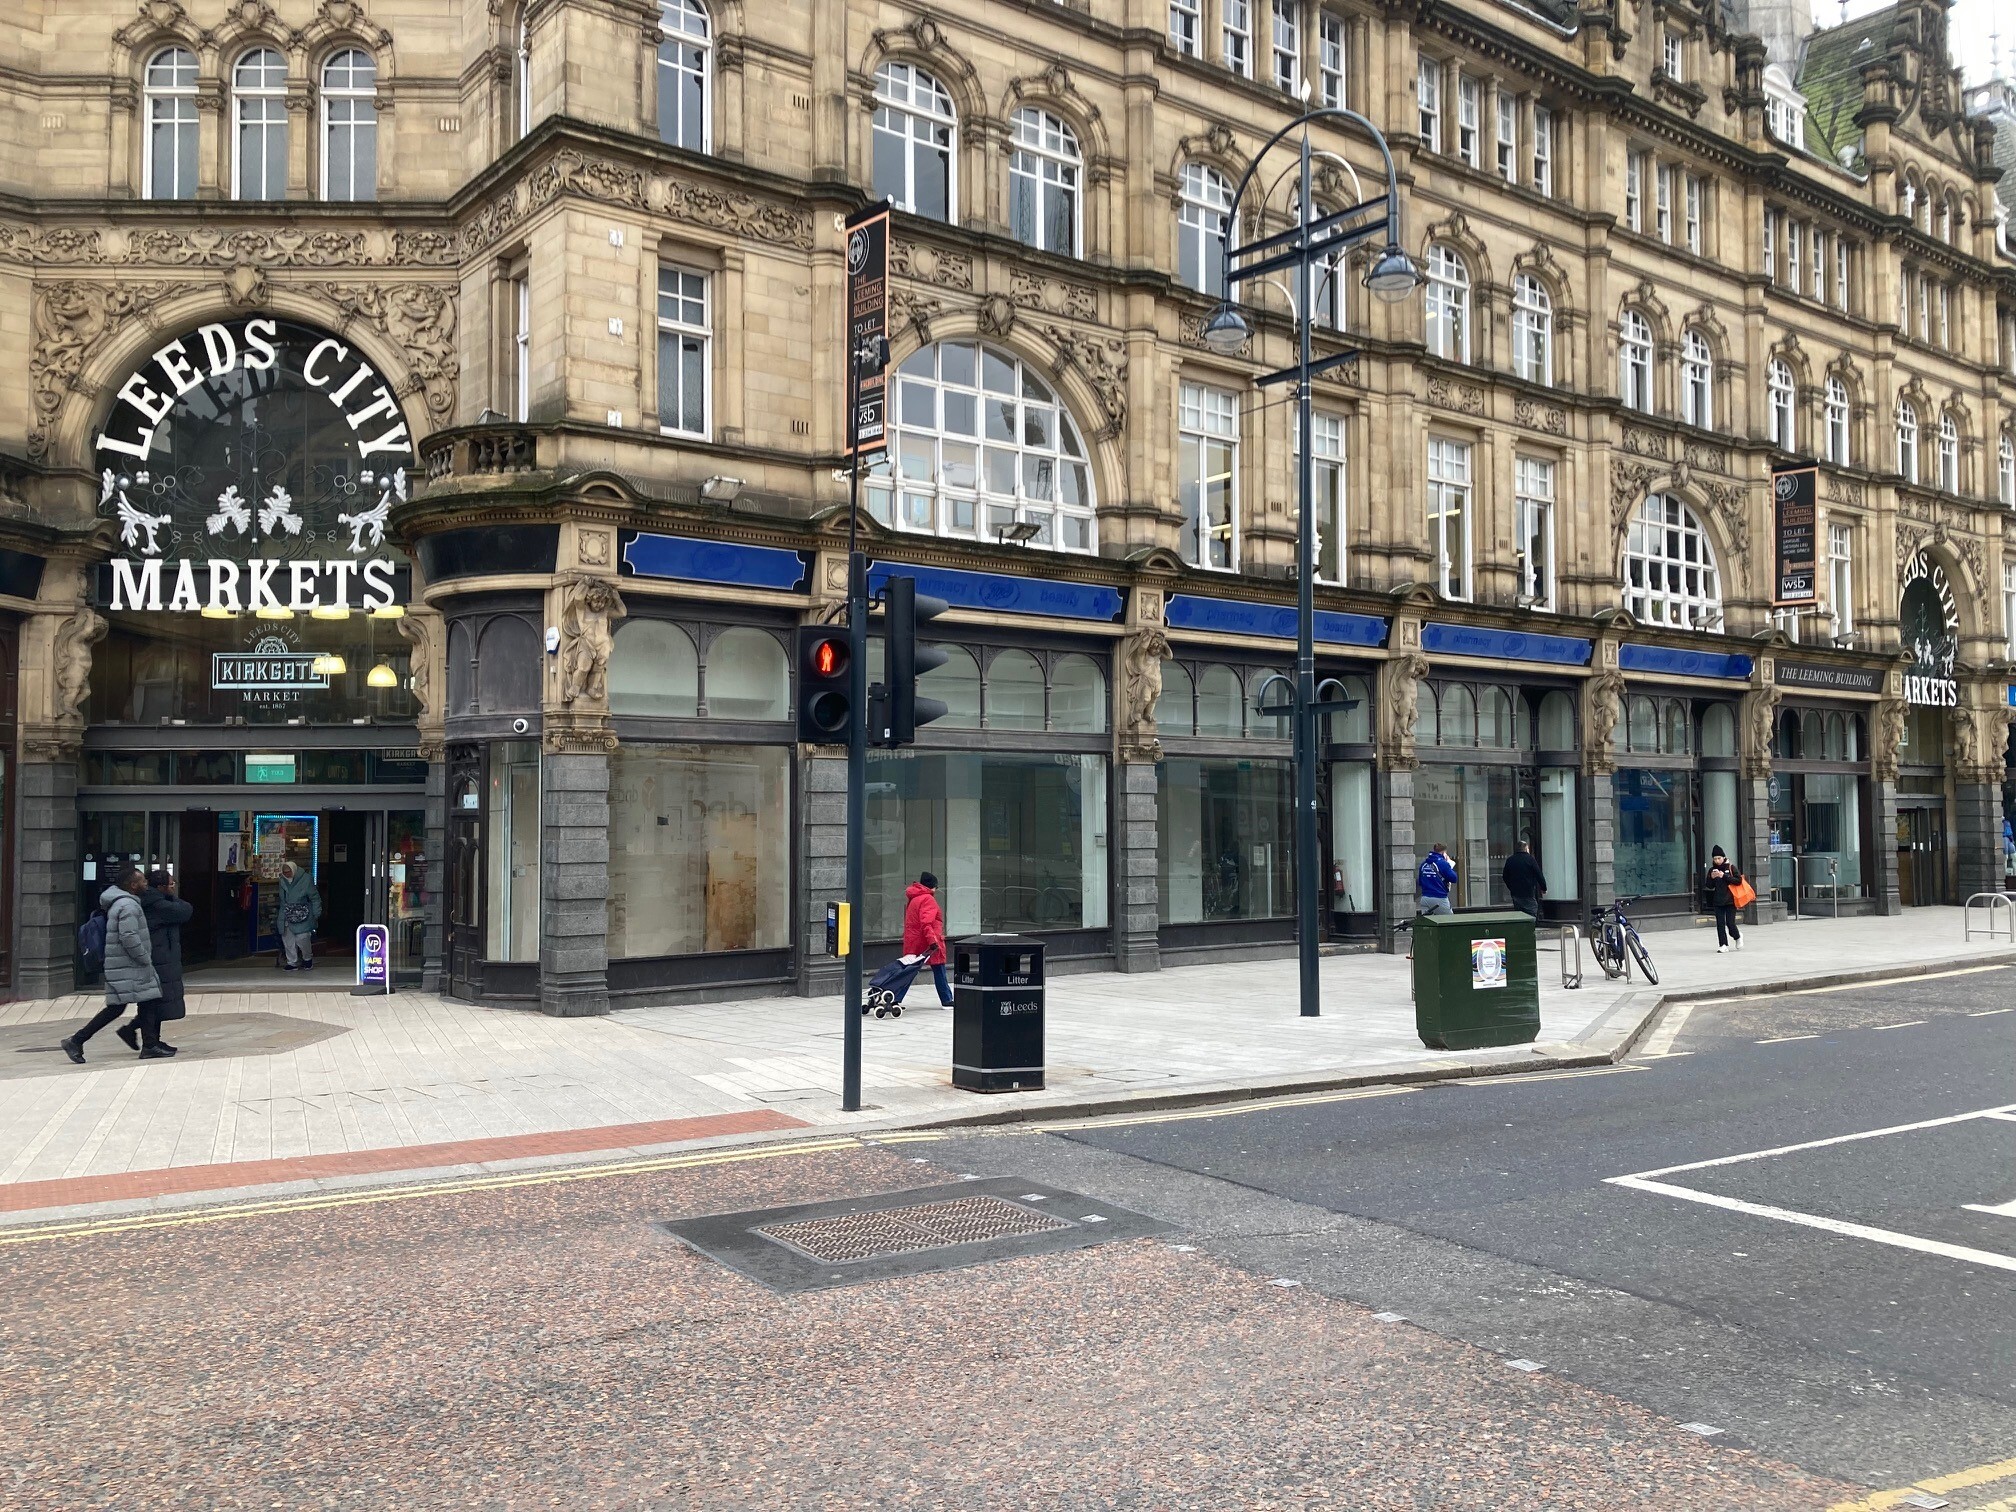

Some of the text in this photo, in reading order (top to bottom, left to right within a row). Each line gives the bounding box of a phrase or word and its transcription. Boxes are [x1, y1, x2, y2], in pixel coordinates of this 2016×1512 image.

[854, 273, 867, 287] THE
[854, 282, 882, 301] LEEMING
[854, 295, 884, 315] BUILDING
[854, 318, 876, 334] TO LET
[96, 319, 412, 461] LEEDS CITY
[109, 558, 395, 611] MARKETS
[1784, 576, 1806, 590] wsb
[1933, 565, 1960, 629] CITY
[243, 622, 301, 645] LEEDS CITY
[222, 661, 321, 681] KIRKGATE
[1781, 666, 1873, 687] THE LEEMING BUILDING
[243, 691, 300, 702] MARKET
[1904, 675, 1957, 707] ARKETS
[386, 749, 416, 758] KIRKGA
[364, 957, 383, 965] VAPE
[364, 966, 384, 974] SHOP
[961, 975, 1029, 985] Litter Litter
[1012, 1001, 1038, 1012] Leeds
